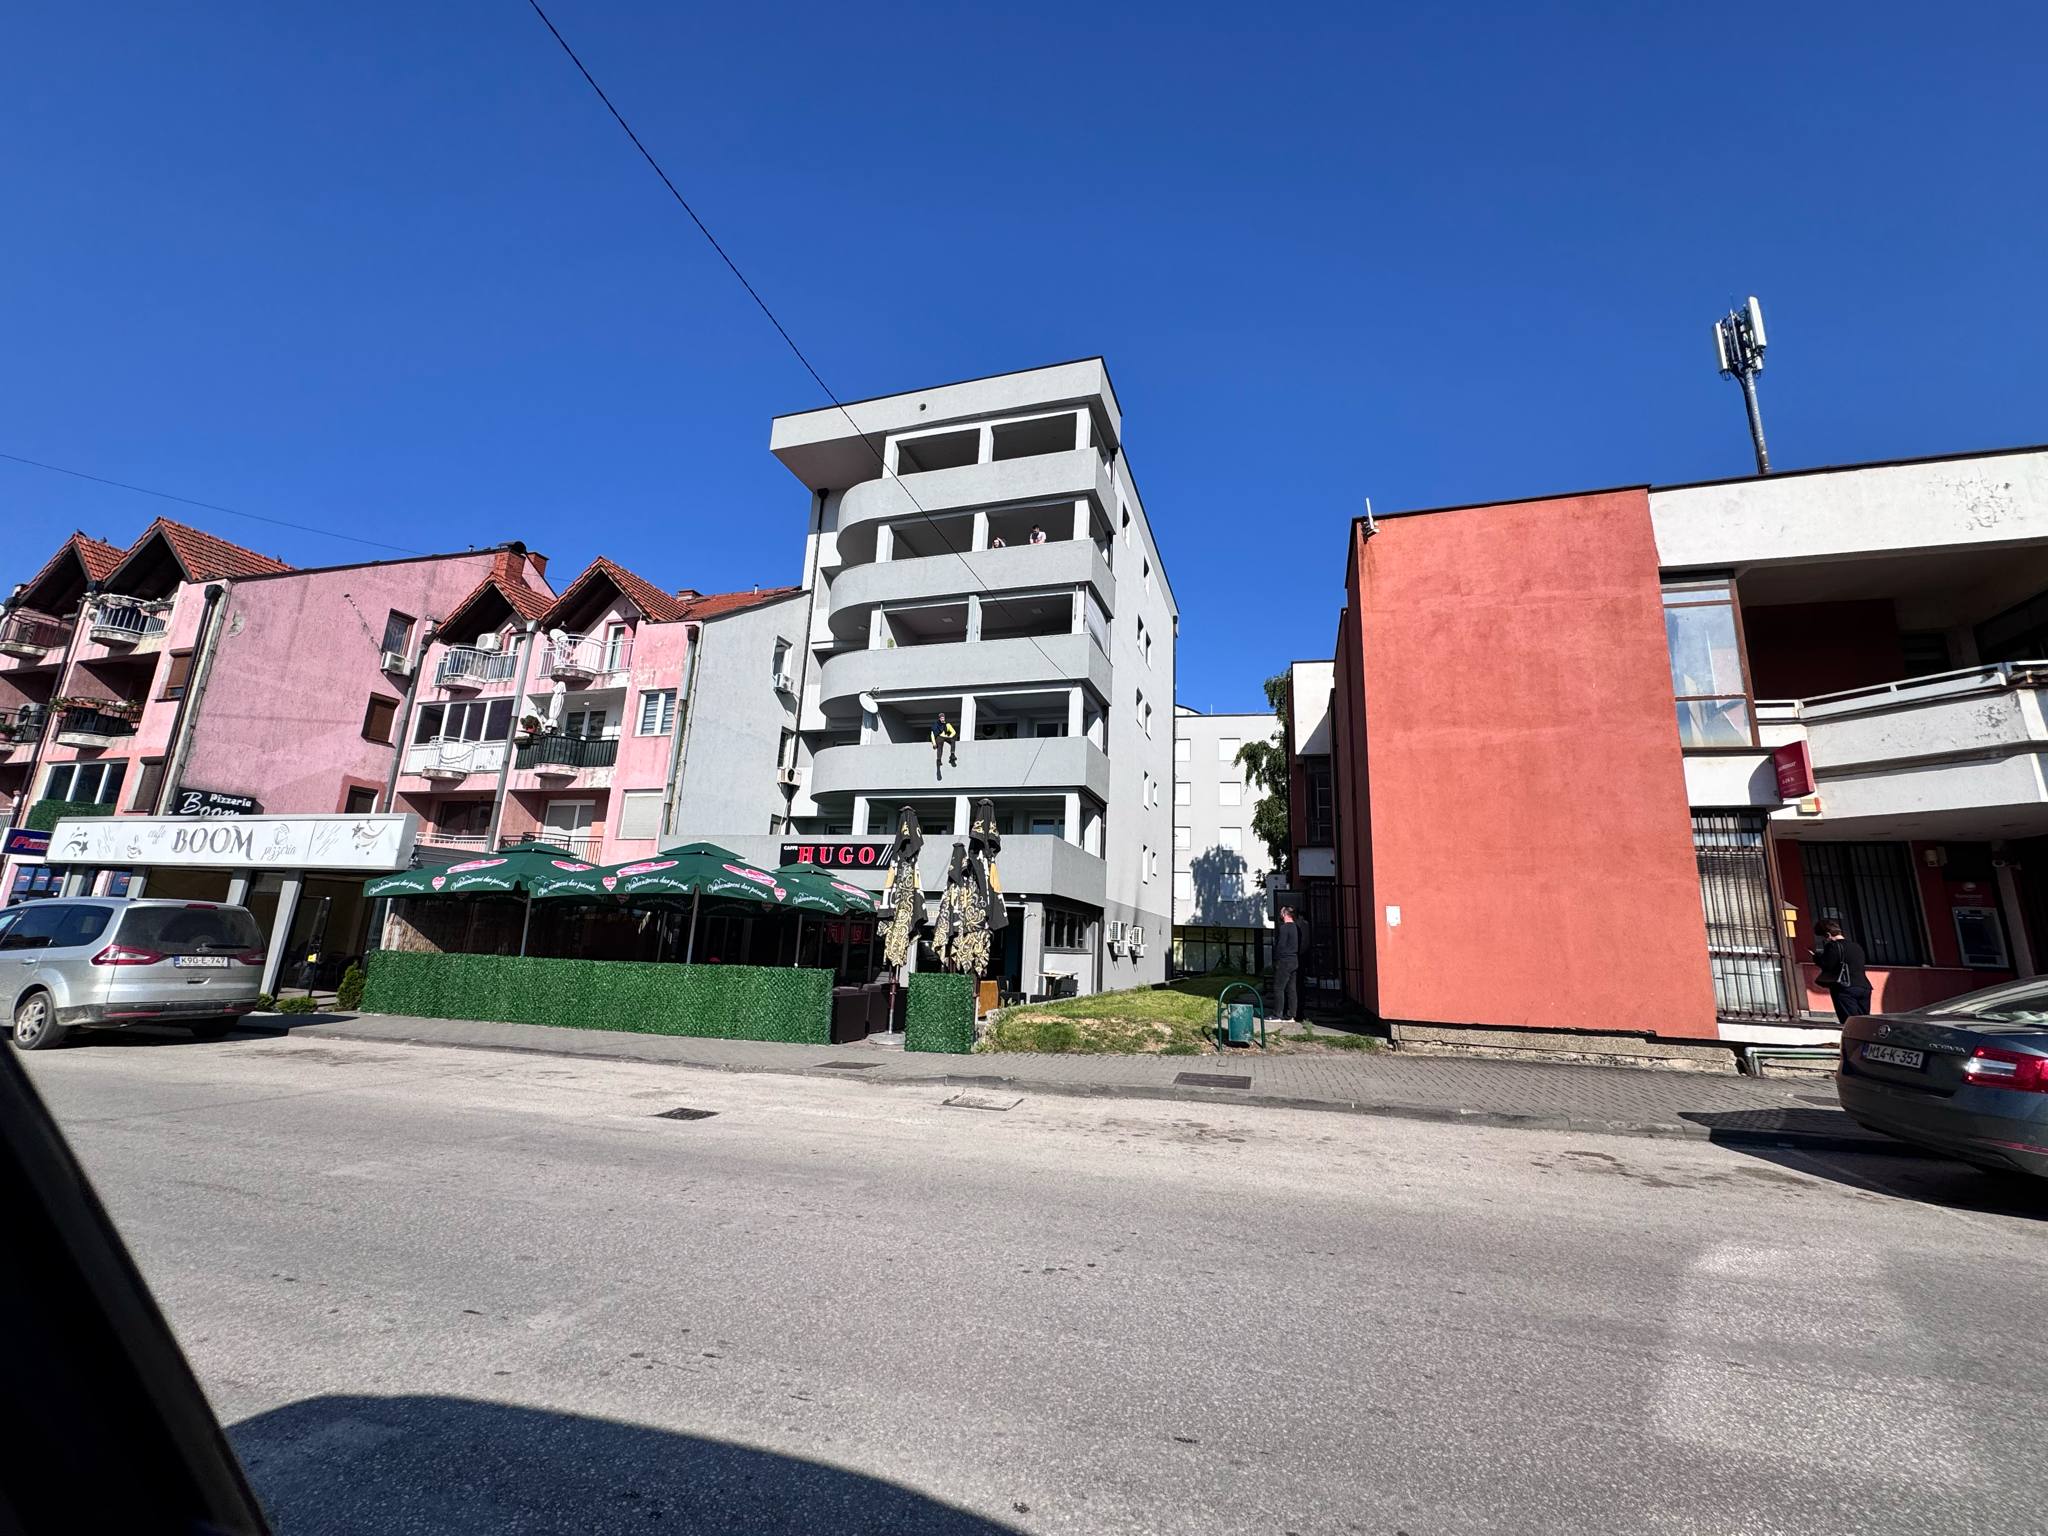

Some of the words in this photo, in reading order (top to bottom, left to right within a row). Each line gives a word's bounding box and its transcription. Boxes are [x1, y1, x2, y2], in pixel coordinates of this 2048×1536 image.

[209, 793, 252, 807] Pizzeria
[171, 825, 255, 861] BOOM
[797, 846, 876, 864] HUGO
